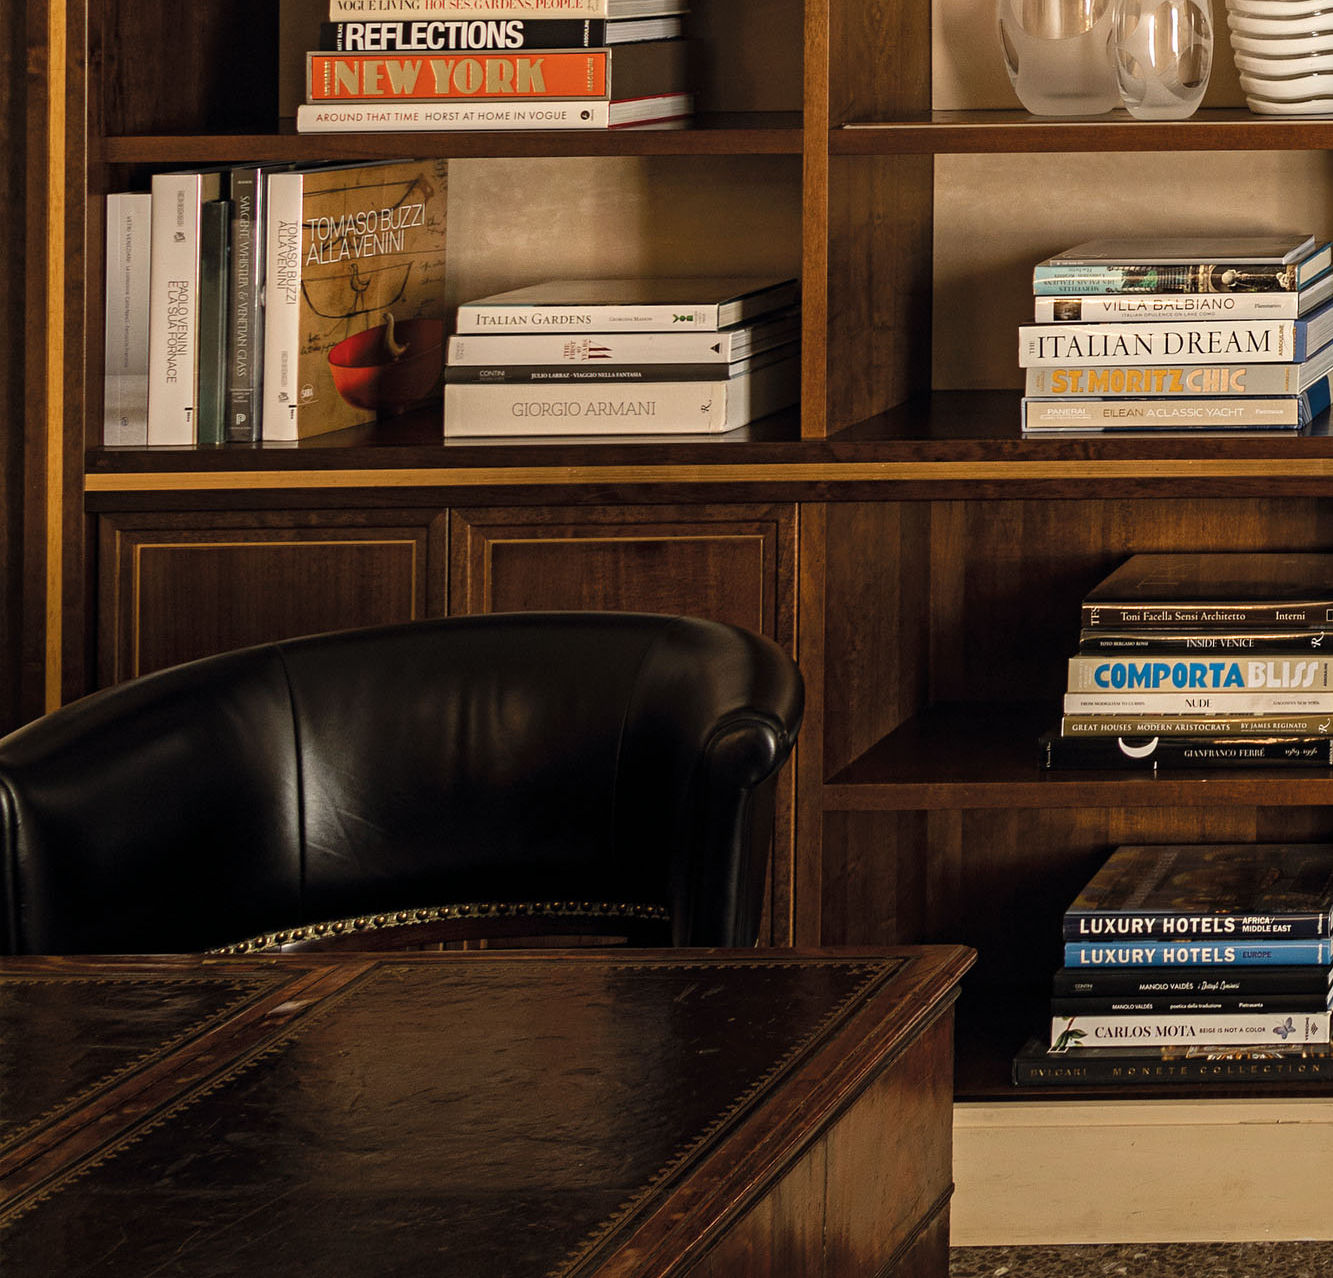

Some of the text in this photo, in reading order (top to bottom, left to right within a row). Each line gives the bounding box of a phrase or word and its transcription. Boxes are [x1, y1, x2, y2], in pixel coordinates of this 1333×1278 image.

[337, 0, 376, 11] VOGUE
[379, 0, 420, 11] LIVING
[346, 21, 524, 50] REFLECTIONS
[335, 59, 423, 96] NEW
[431, 58, 547, 94] YORK
[316, 111, 567, 122] AROUND THAT TIME HORST AT HOME IN VOGUE
[306, 203, 425, 241] TOMASO BUZZI
[306, 232, 404, 266] ALLA VENINI
[1103, 298, 1235, 311] VILLA BALBIANO
[476, 314, 592, 326] ITALIAN GARDENS
[1037, 329, 1271, 358] ITALIAN DREAM
[1187, 369, 1246, 392] CHIC
[512, 402, 656, 416] GIORGIO ARMANI
[1121, 611, 1305, 621] Toni Facella Sensi Architetto Interni
[1186, 639, 1254, 648] INSIDE VENICE
[1095, 662, 1244, 688] COMPORTA
[1248, 662, 1320, 687] BLISS
[1185, 698, 1212, 707] NUDE
[1080, 918, 1235, 933] LUXURY HOTELS
[1080, 949, 1155, 963] LUXURY
[1163, 948, 1235, 962] HOTELS
[1171, 981, 1193, 989] VALDÉS
[1095, 1027, 1151, 1038] CARLOS
[1155, 1026, 1196, 1037] MOTA
